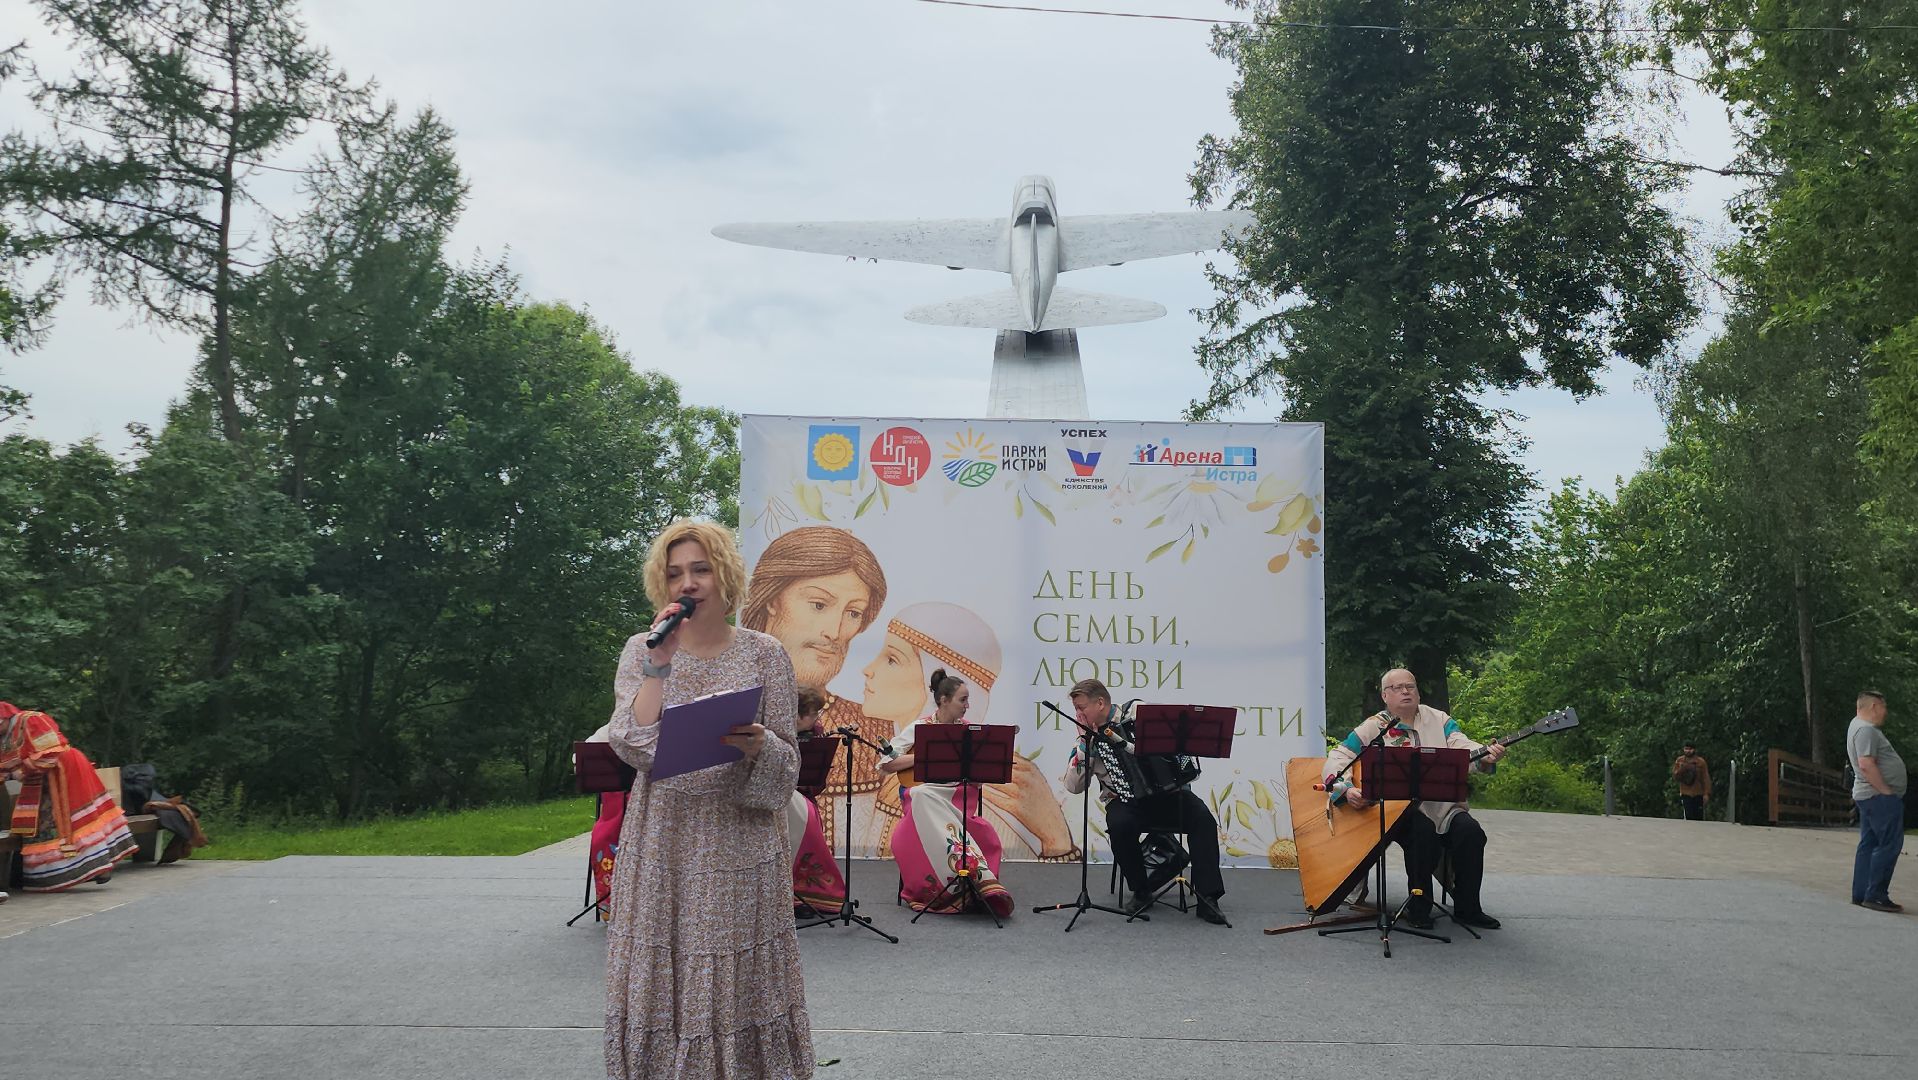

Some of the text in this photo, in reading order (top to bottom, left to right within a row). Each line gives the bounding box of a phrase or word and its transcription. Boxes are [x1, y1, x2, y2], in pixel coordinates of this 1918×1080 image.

[1060, 428, 1108, 439] УСПЕХ
[1001, 445, 1047, 458] ПАРКИ
[1159, 447, 1223, 467] Арена
[1001, 458, 1047, 472] ИСТРЫ
[1206, 467, 1257, 484] Истра
[1032, 569, 1145, 601] ДЕНЬ
[1033, 613, 1190, 649] СЕМЬИ,
[1031, 656, 1185, 691] ЛЮБВИ
[1034, 701, 1063, 731] И
